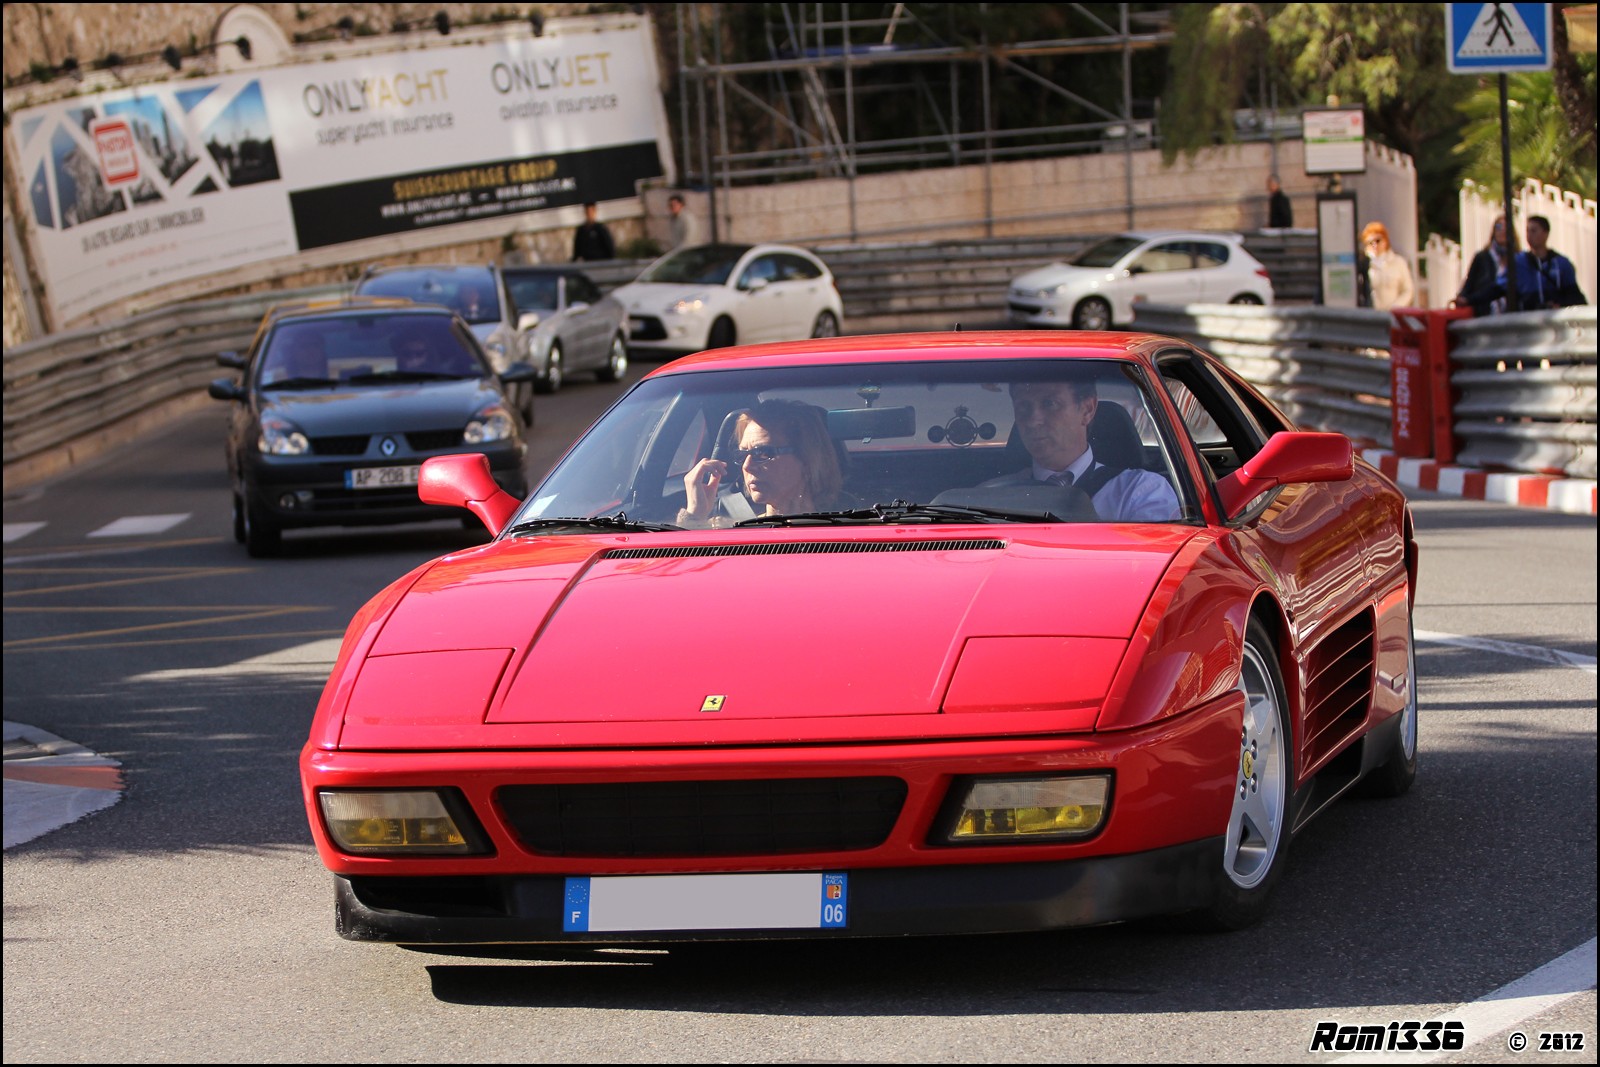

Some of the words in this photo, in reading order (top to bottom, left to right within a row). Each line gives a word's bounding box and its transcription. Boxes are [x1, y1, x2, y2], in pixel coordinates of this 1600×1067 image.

[556, 94, 618, 114] insurance
[392, 112, 454, 136] insurance
[508, 159, 557, 183] GROUP
[571, 911, 581, 923] F
[824, 904, 843, 923] 06
